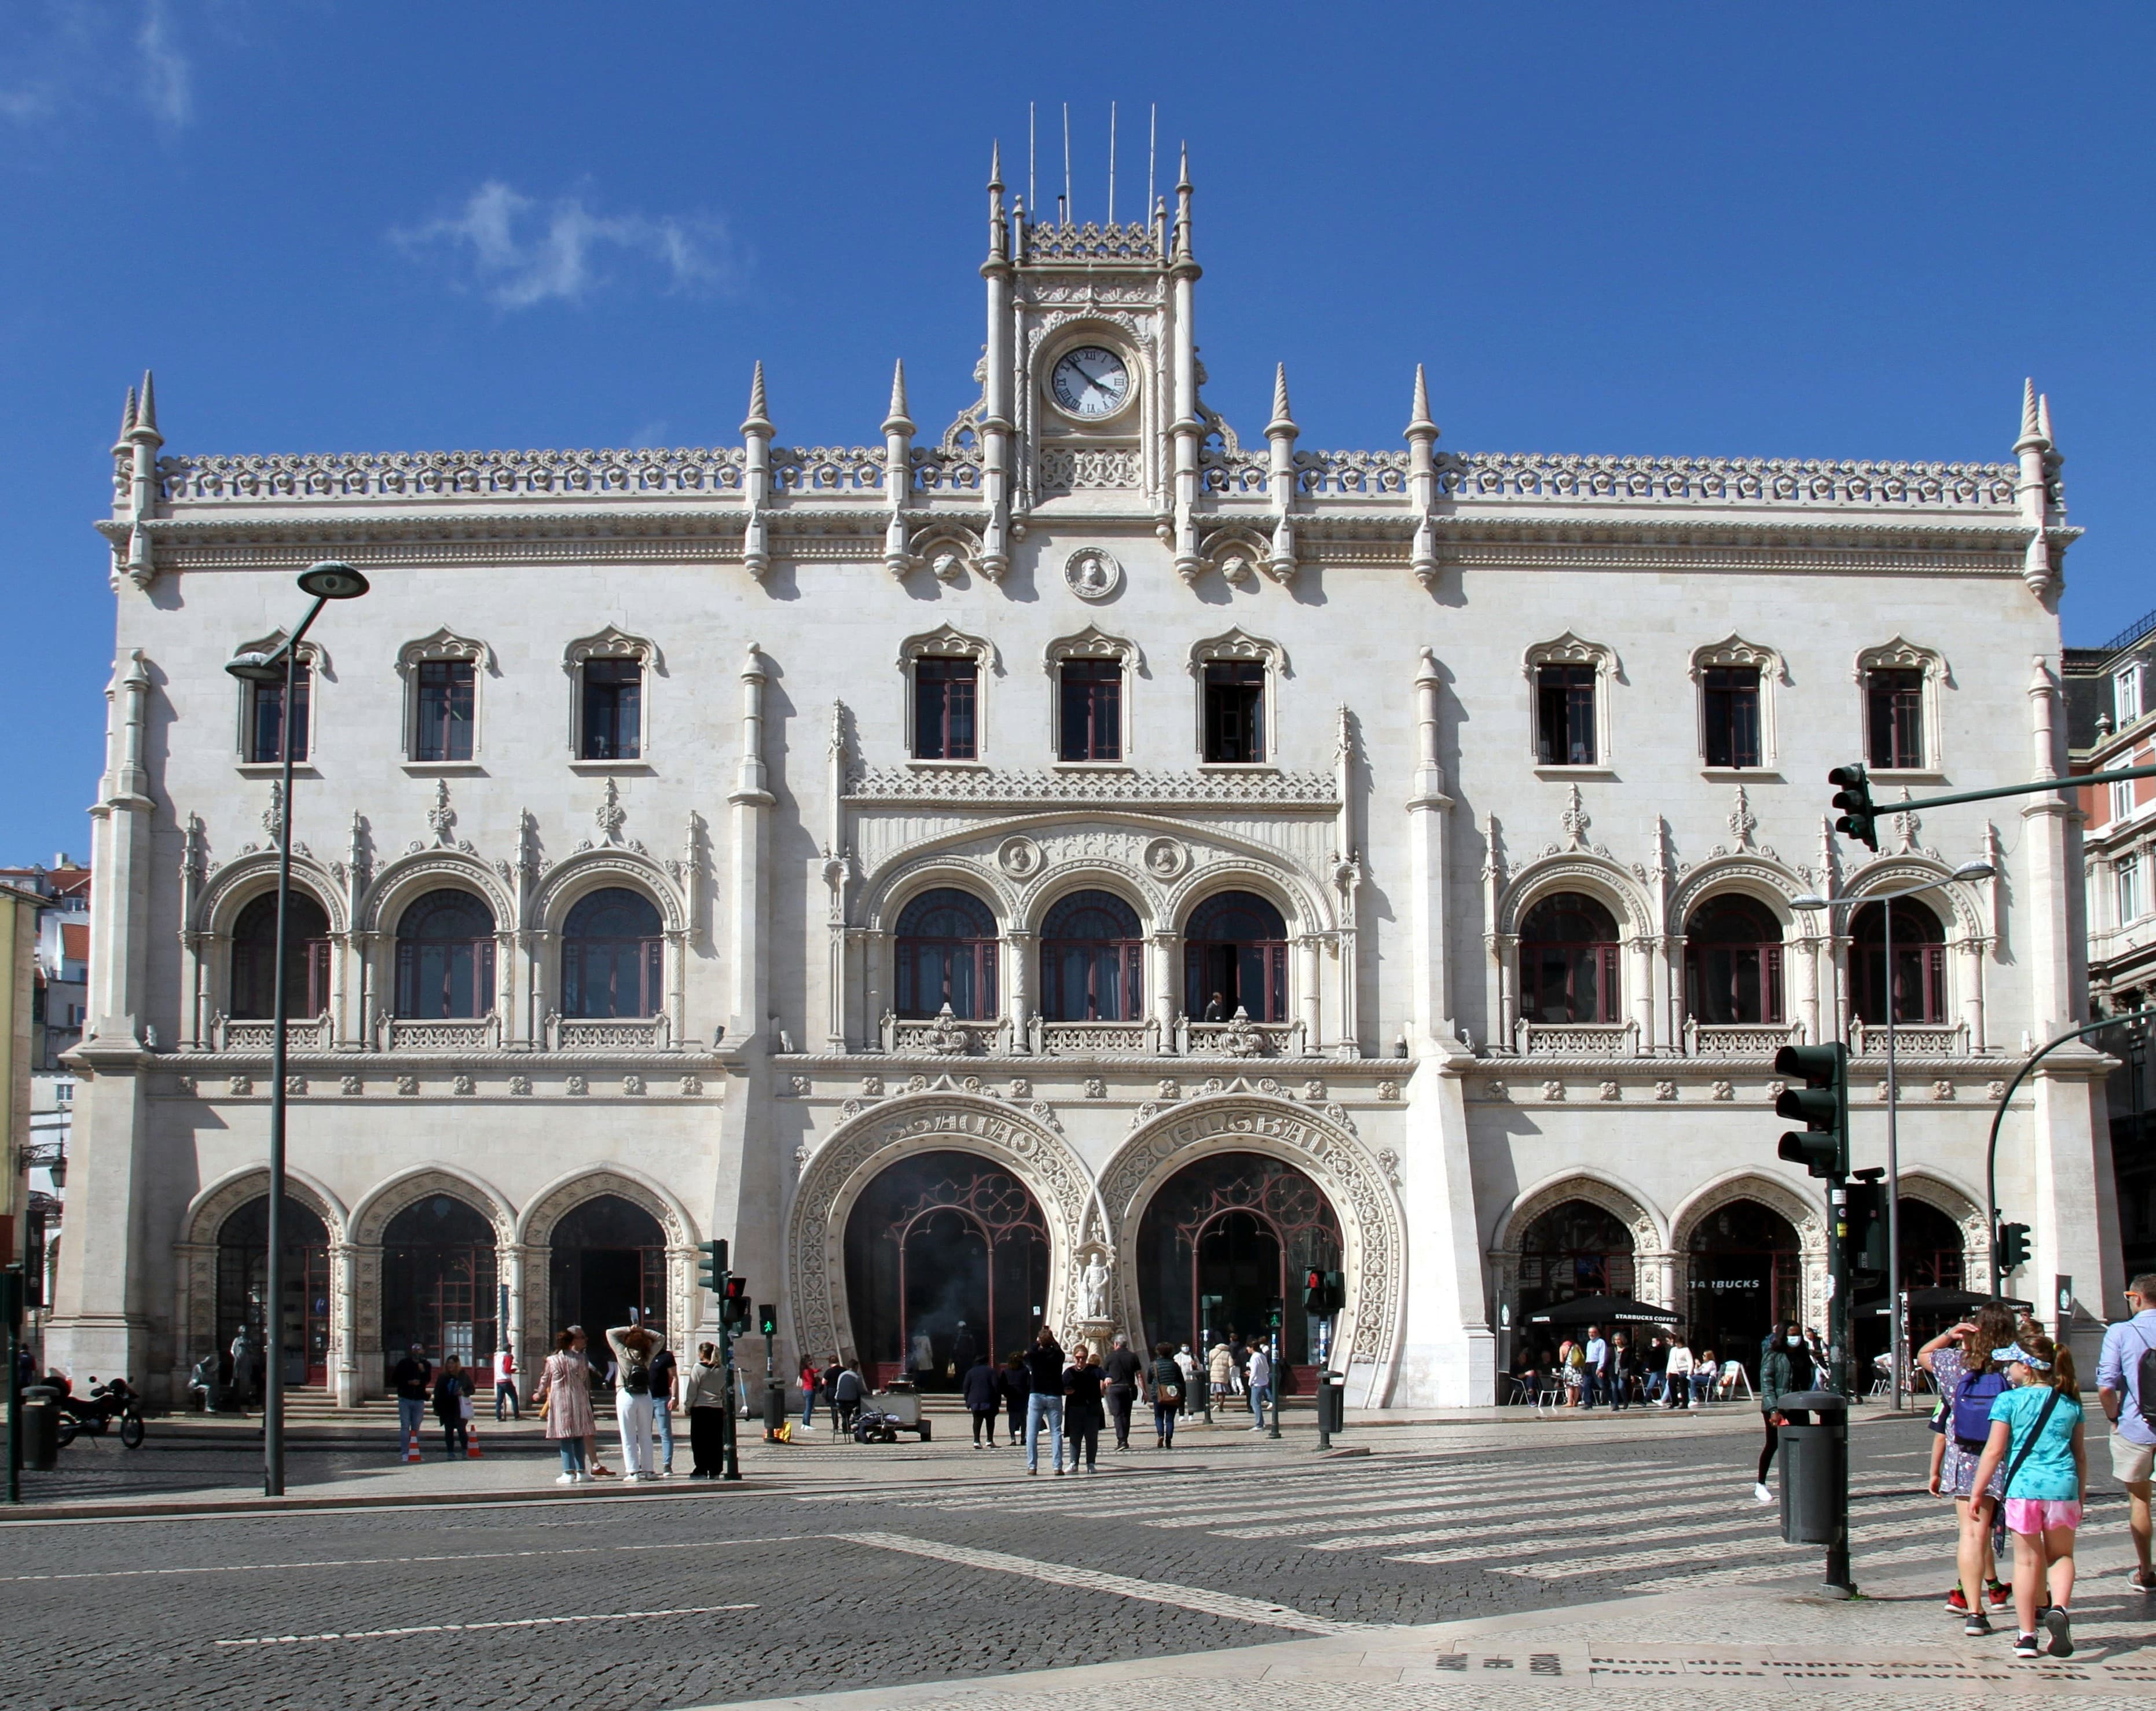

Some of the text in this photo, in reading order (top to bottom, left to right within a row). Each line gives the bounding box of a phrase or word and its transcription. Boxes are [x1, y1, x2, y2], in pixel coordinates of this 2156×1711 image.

[1084, 351, 1095, 360] XII
[1101, 355, 1108, 363] I
[1087, 404, 1095, 413] VI
[1435, 1653, 1468, 1671] ABRIL
[1530, 1653, 1561, 1675] LISBOA
